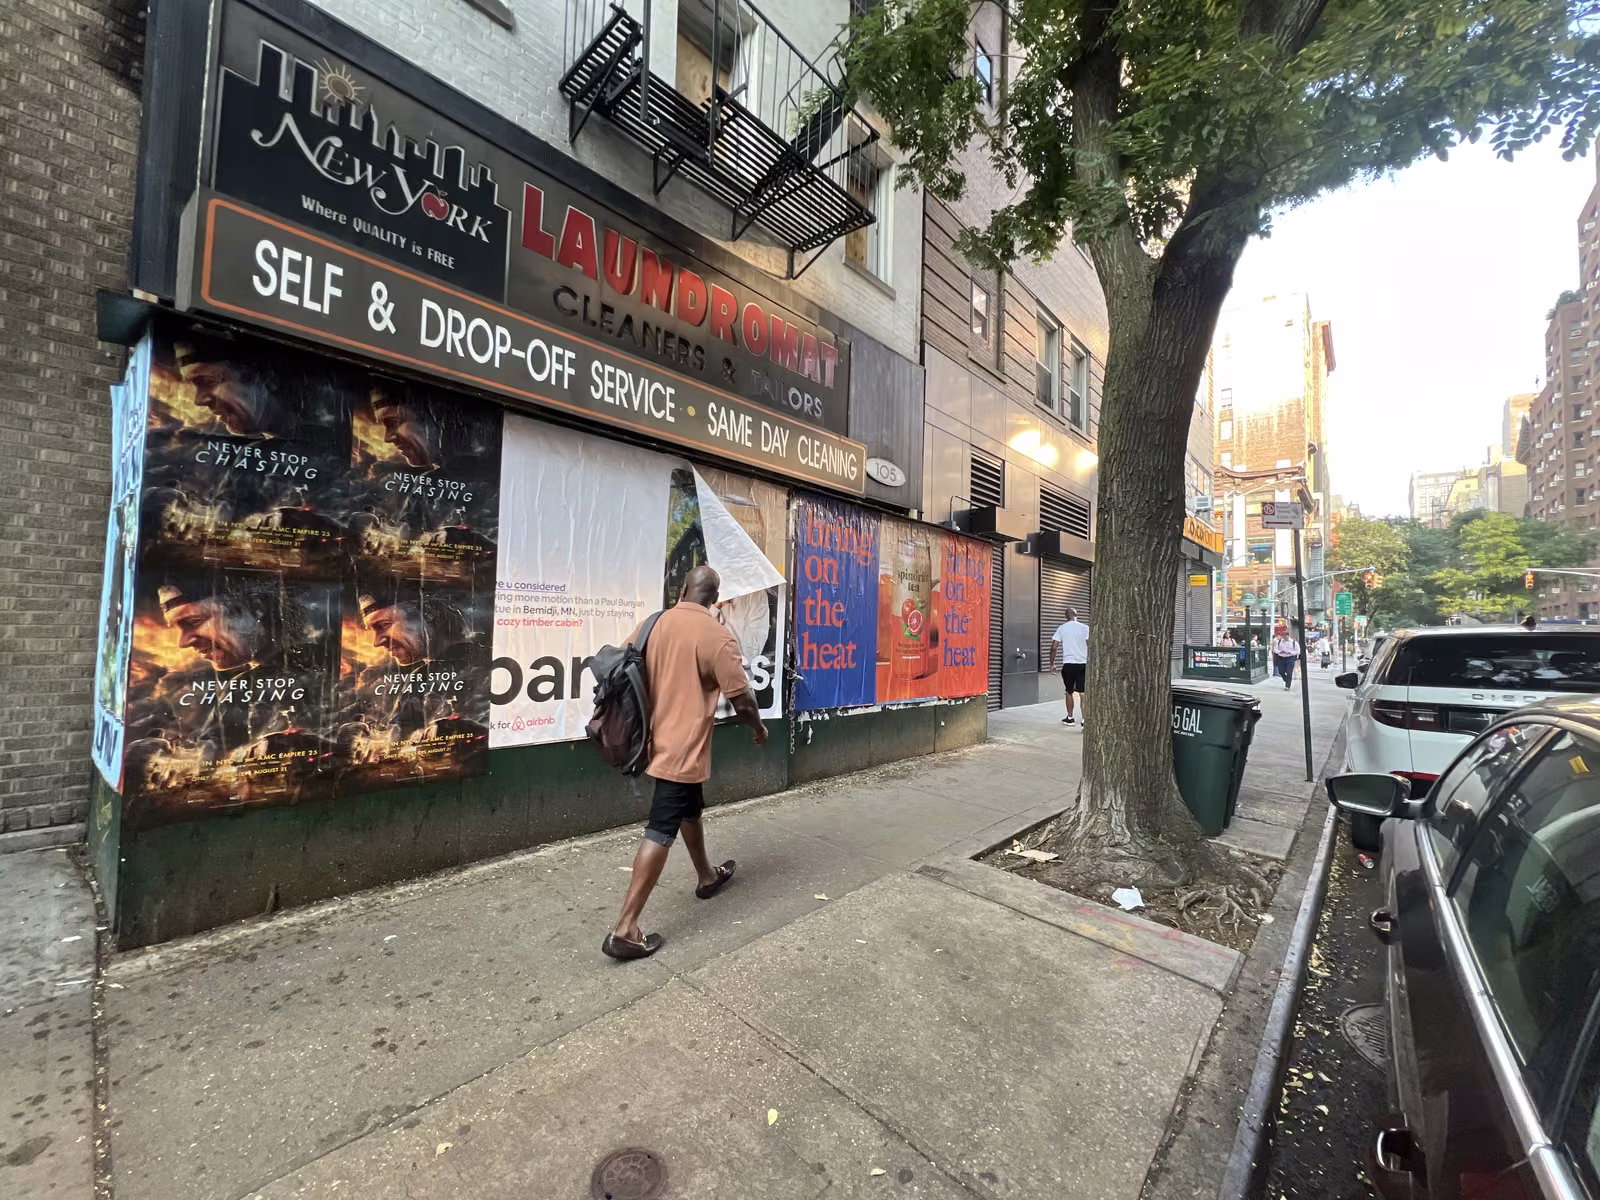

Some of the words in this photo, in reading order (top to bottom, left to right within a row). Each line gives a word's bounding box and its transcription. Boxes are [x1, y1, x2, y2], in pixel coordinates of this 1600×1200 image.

[301, 194, 347, 224] Where
[353, 217, 408, 249] QUALITY
[412, 241, 423, 256] is
[427, 247, 455, 270] FREE
[521, 181, 839, 389] LAUNDROMAT
[252, 239, 344, 315] SELF
[367, 281, 396, 334] &
[420, 298, 576, 389] DROP-OFF
[590, 360, 675, 423] SERVICE
[707, 401, 753, 448] SAME
[761, 420, 789, 458] DAY
[797, 435, 858, 481] CLEANING
[552, 285, 706, 372] CLEANERS
[721, 357, 737, 385] &
[751, 369, 823, 419] TAILORS
[207, 440, 262, 459] NEVER
[270, 451, 309, 466] STOP
[195, 450, 318, 480] CHASING
[875, 462, 897, 482] 105
[384, 480, 473, 502] CHASING
[393, 471, 432, 486] NEVER
[438, 479, 466, 490] STOP
[293, 528, 319, 537] EMPIRE
[807, 506, 873, 567] bring
[805, 555, 839, 585] on
[514, 581, 566, 592] considered
[945, 580, 964, 602] on
[512, 604, 522, 614] in
[578, 608, 594, 618] just
[595, 609, 606, 619] by
[607, 610, 635, 619] staying
[515, 593, 540, 603] more
[541, 595, 573, 605] motion
[574, 596, 594, 606] than
[601, 598, 618, 607] Paul
[618, 599, 645, 608] Bunyan
[803, 587, 845, 628] the
[496, 619, 520, 628] cozy
[522, 618, 554, 627] timber
[555, 618, 584, 627] cabin?
[943, 605, 969, 635] the
[801, 631, 857, 671] heat
[943, 638, 976, 667] heat
[192, 679, 248, 691] NEVER
[256, 678, 295, 689] STOP
[374, 680, 464, 696] CHASING
[383, 673, 423, 683] NEVER
[428, 672, 457, 681] STOP
[179, 688, 305, 706] CHASING
[497, 720, 511, 729] for
[526, 715, 556, 727] airbnb
[1182, 707, 1203, 733] GAL
[257, 752, 276, 761] AMC
[279, 749, 306, 759] EMPIRE
[254, 767, 279, 776] AUGUST
